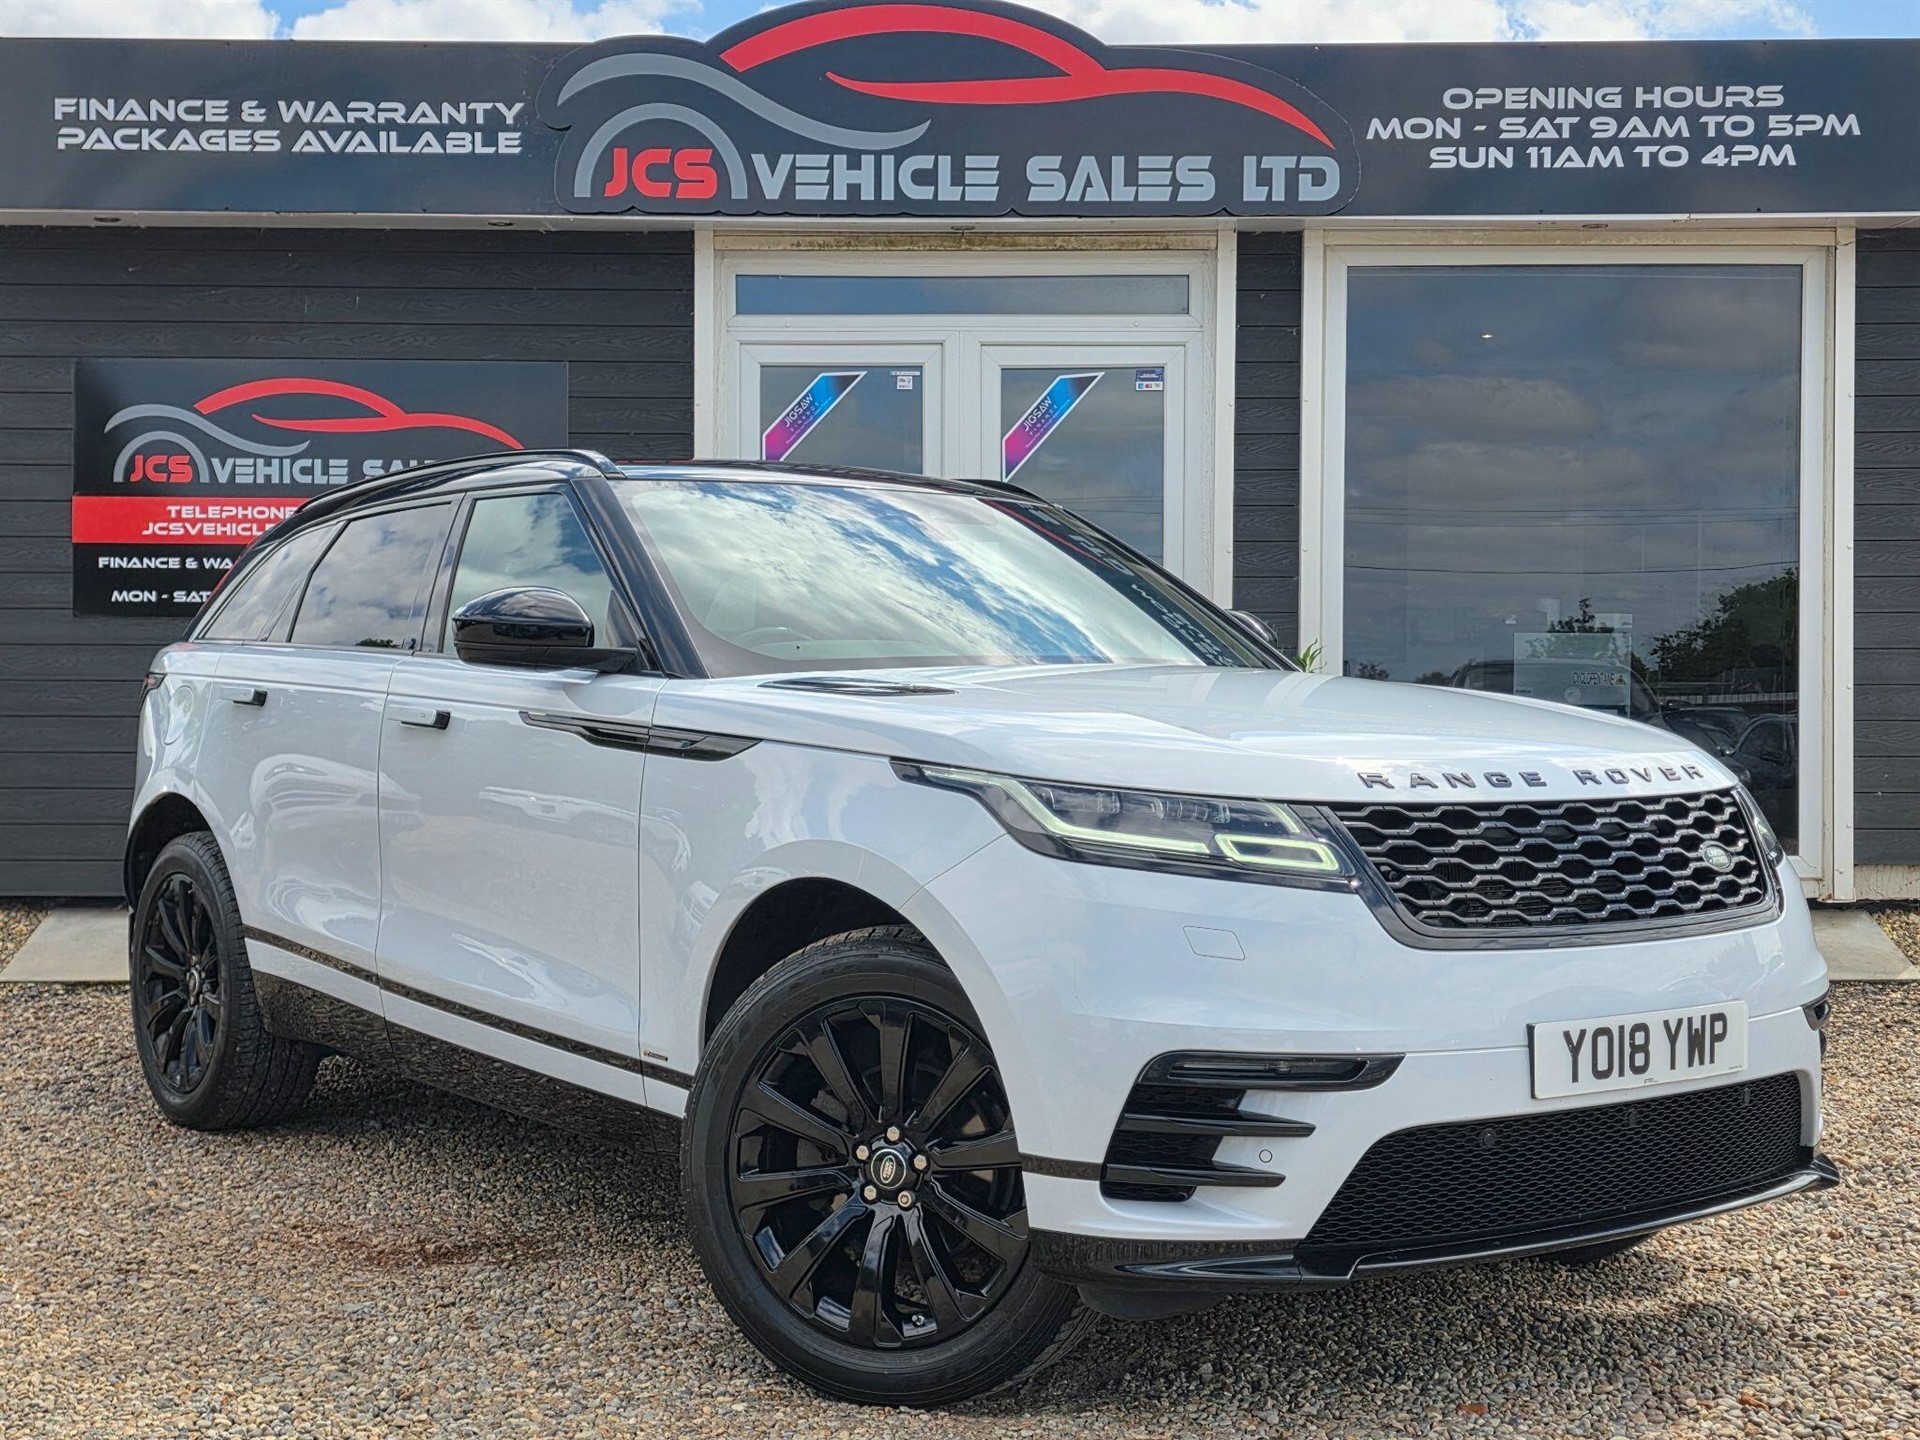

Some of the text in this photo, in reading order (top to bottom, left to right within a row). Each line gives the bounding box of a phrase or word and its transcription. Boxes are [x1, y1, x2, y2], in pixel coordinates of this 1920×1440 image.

[1442, 84, 1785, 110] OPENING HOURS
[54, 97, 525, 125] FINANCE & WARRANTY
[1365, 116, 1461, 140] MON
[1498, 116, 1581, 140] SAT
[1590, 115, 1691, 139] 9AM
[1698, 114, 1755, 138] TO
[1767, 113, 1862, 137] 5PM
[57, 127, 523, 154] PACKAGES AVAILABLE
[1428, 143, 1797, 169] SUN 11AM TO 4PM
[603, 147, 1341, 202] JCS VEHICLE SALES LTD
[784, 393, 814, 428] JIGSAW
[1023, 396, 1053, 432] JIGSAW
[129, 454, 193, 483] JCS
[210, 457, 349, 485] VEHICLE
[98, 556, 180, 569] FINANCE
[184, 556, 199, 569] &
[111, 589, 158, 603] MON
[172, 590, 213, 603] SAT
[1357, 763, 1705, 789] RANGE ROVER
[1562, 1011, 1728, 1083] YO18 YWP
